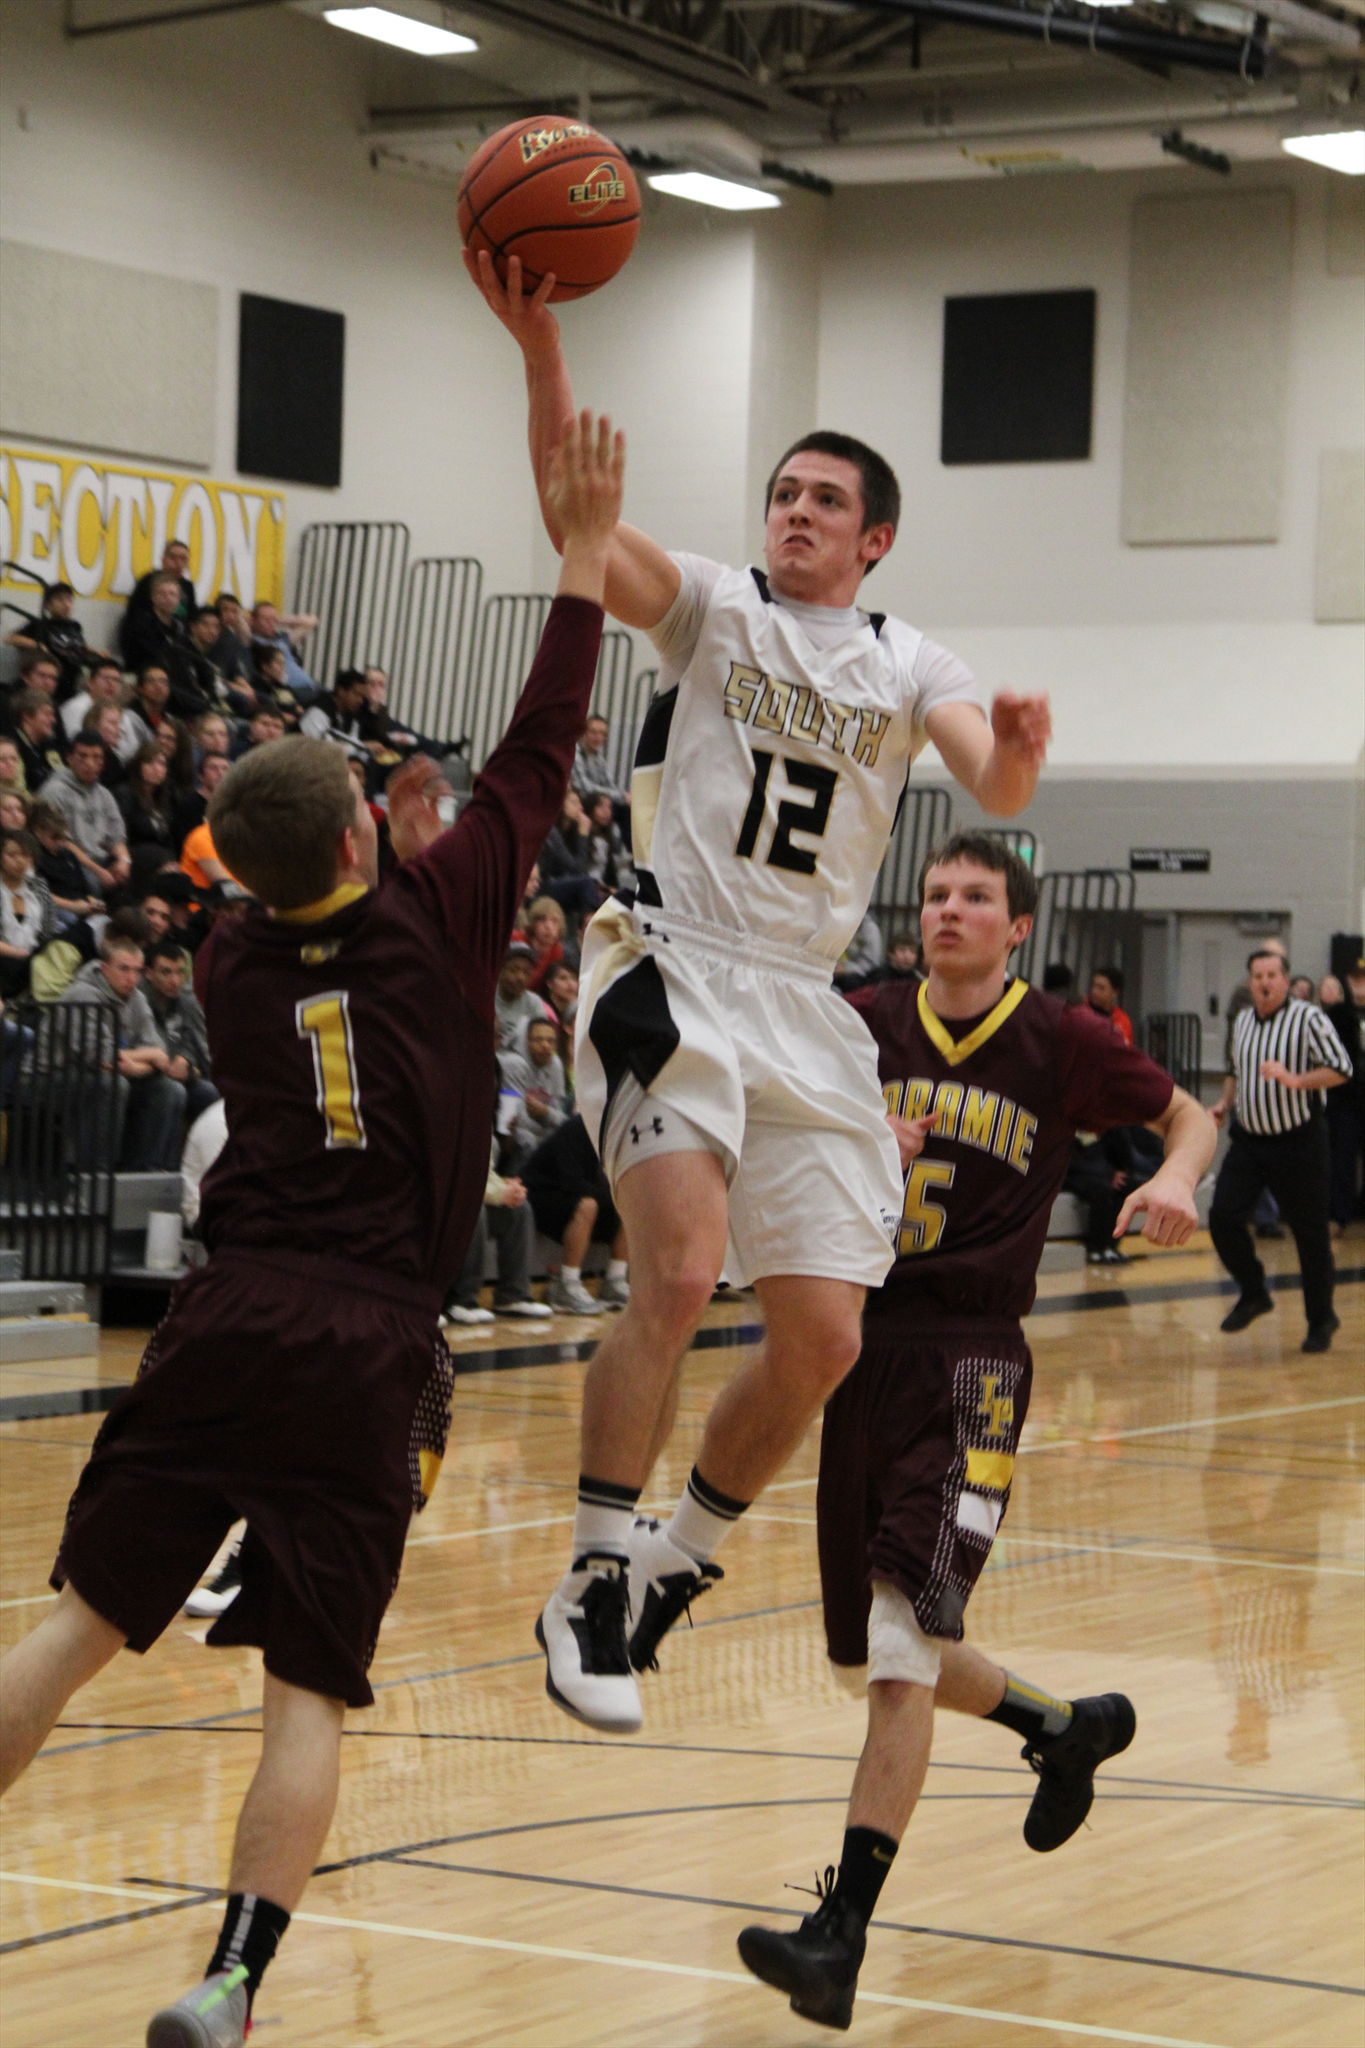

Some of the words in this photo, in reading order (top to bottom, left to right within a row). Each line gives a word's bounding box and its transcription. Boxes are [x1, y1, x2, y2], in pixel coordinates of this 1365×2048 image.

[568, 181, 625, 205] ELITE
[723, 660, 892, 769] SOUTH
[735, 747, 840, 877] 12
[295, 989, 367, 1150] 1
[896, 1157, 957, 1256] 5
